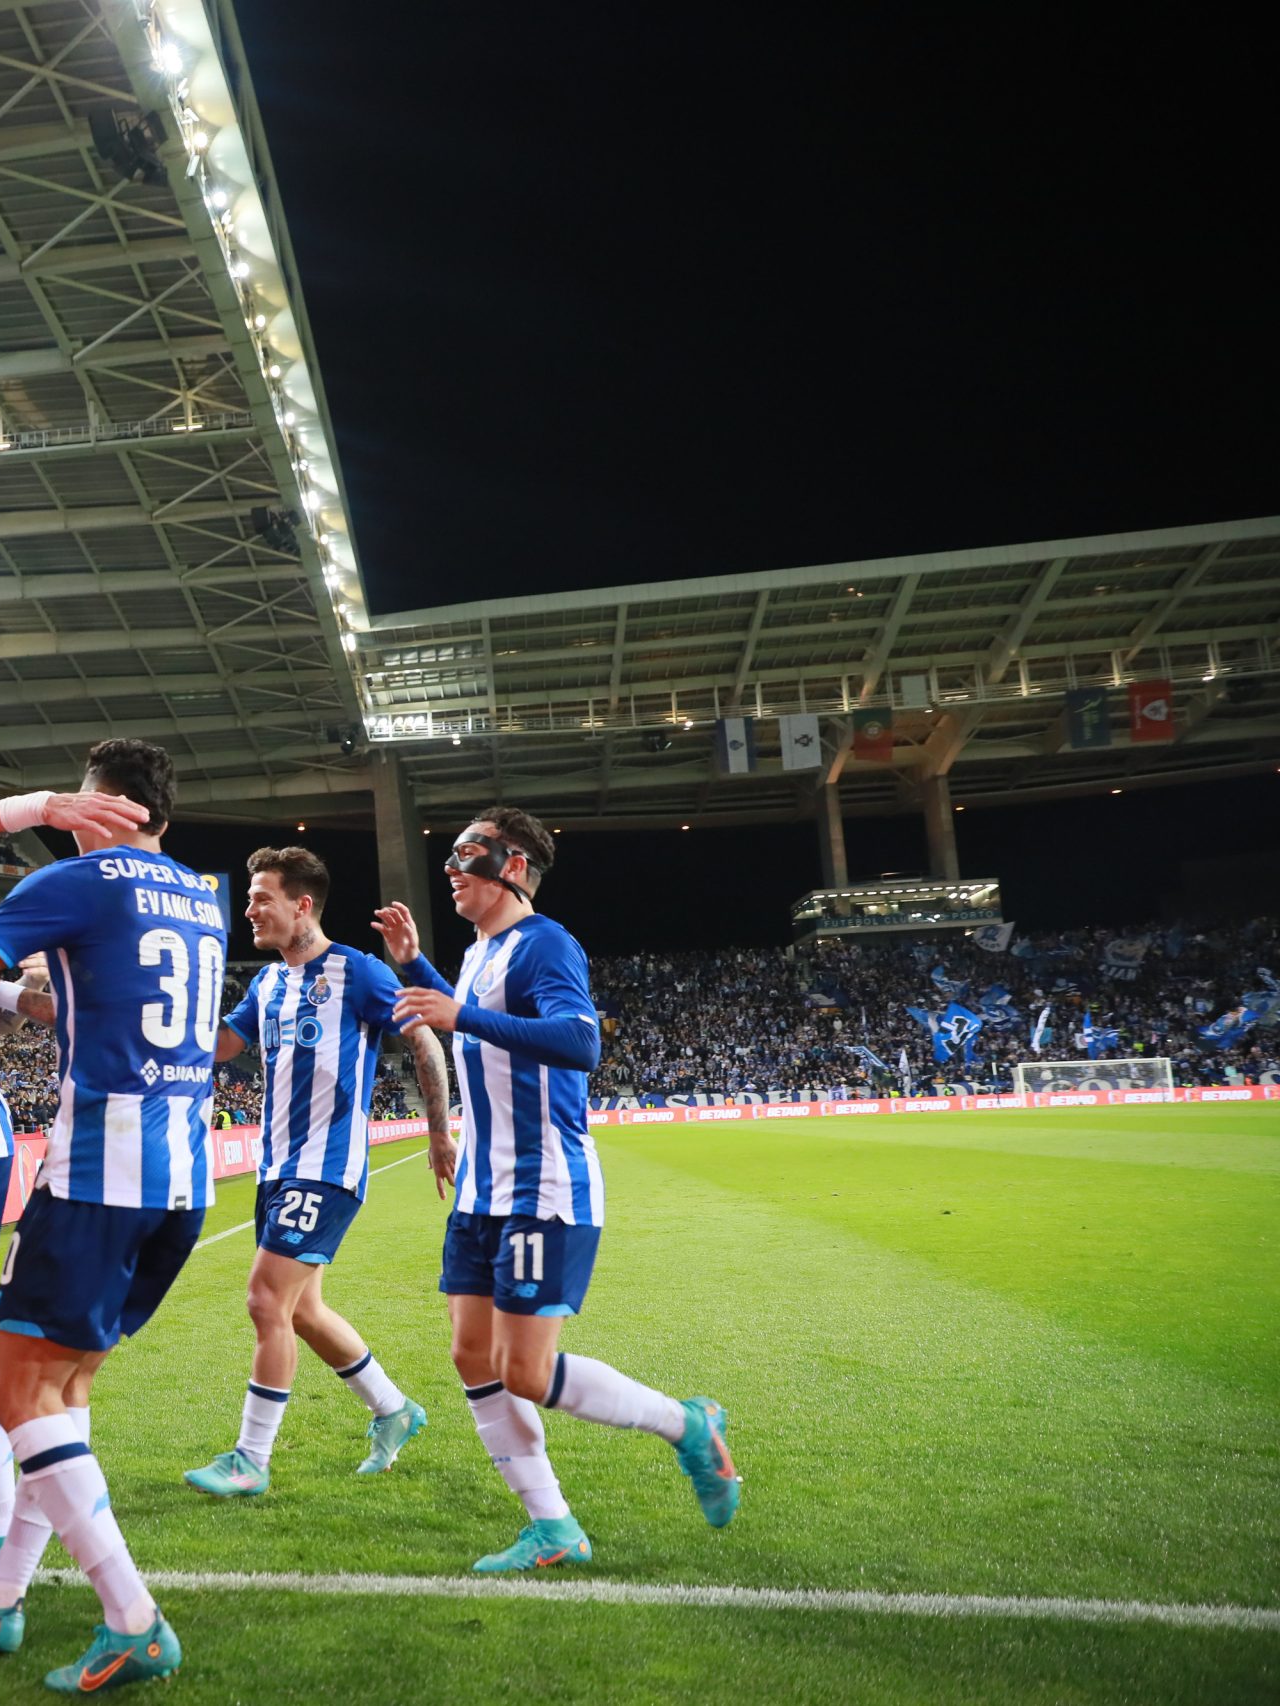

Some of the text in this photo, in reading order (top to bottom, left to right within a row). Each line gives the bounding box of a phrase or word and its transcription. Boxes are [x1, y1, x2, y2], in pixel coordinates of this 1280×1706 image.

[99, 858, 178, 885] SUPER
[134, 887, 224, 930] EVANILSON
[823, 915, 879, 928] FUTEBOL
[951, 910, 995, 921] PORTO
[138, 928, 225, 1053] 30
[1049, 1094, 1098, 1106] BETANO
[1201, 1089, 1253, 1101] BETANO
[766, 1105, 811, 1117] BETANO
[835, 1102, 880, 1114] BETANO
[905, 1100, 951, 1112] BETANO
[632, 1111, 675, 1123] BETANO
[698, 1108, 742, 1120] BETANO
[277, 1190, 324, 1232] 25
[509, 1232, 545, 1281] 11
